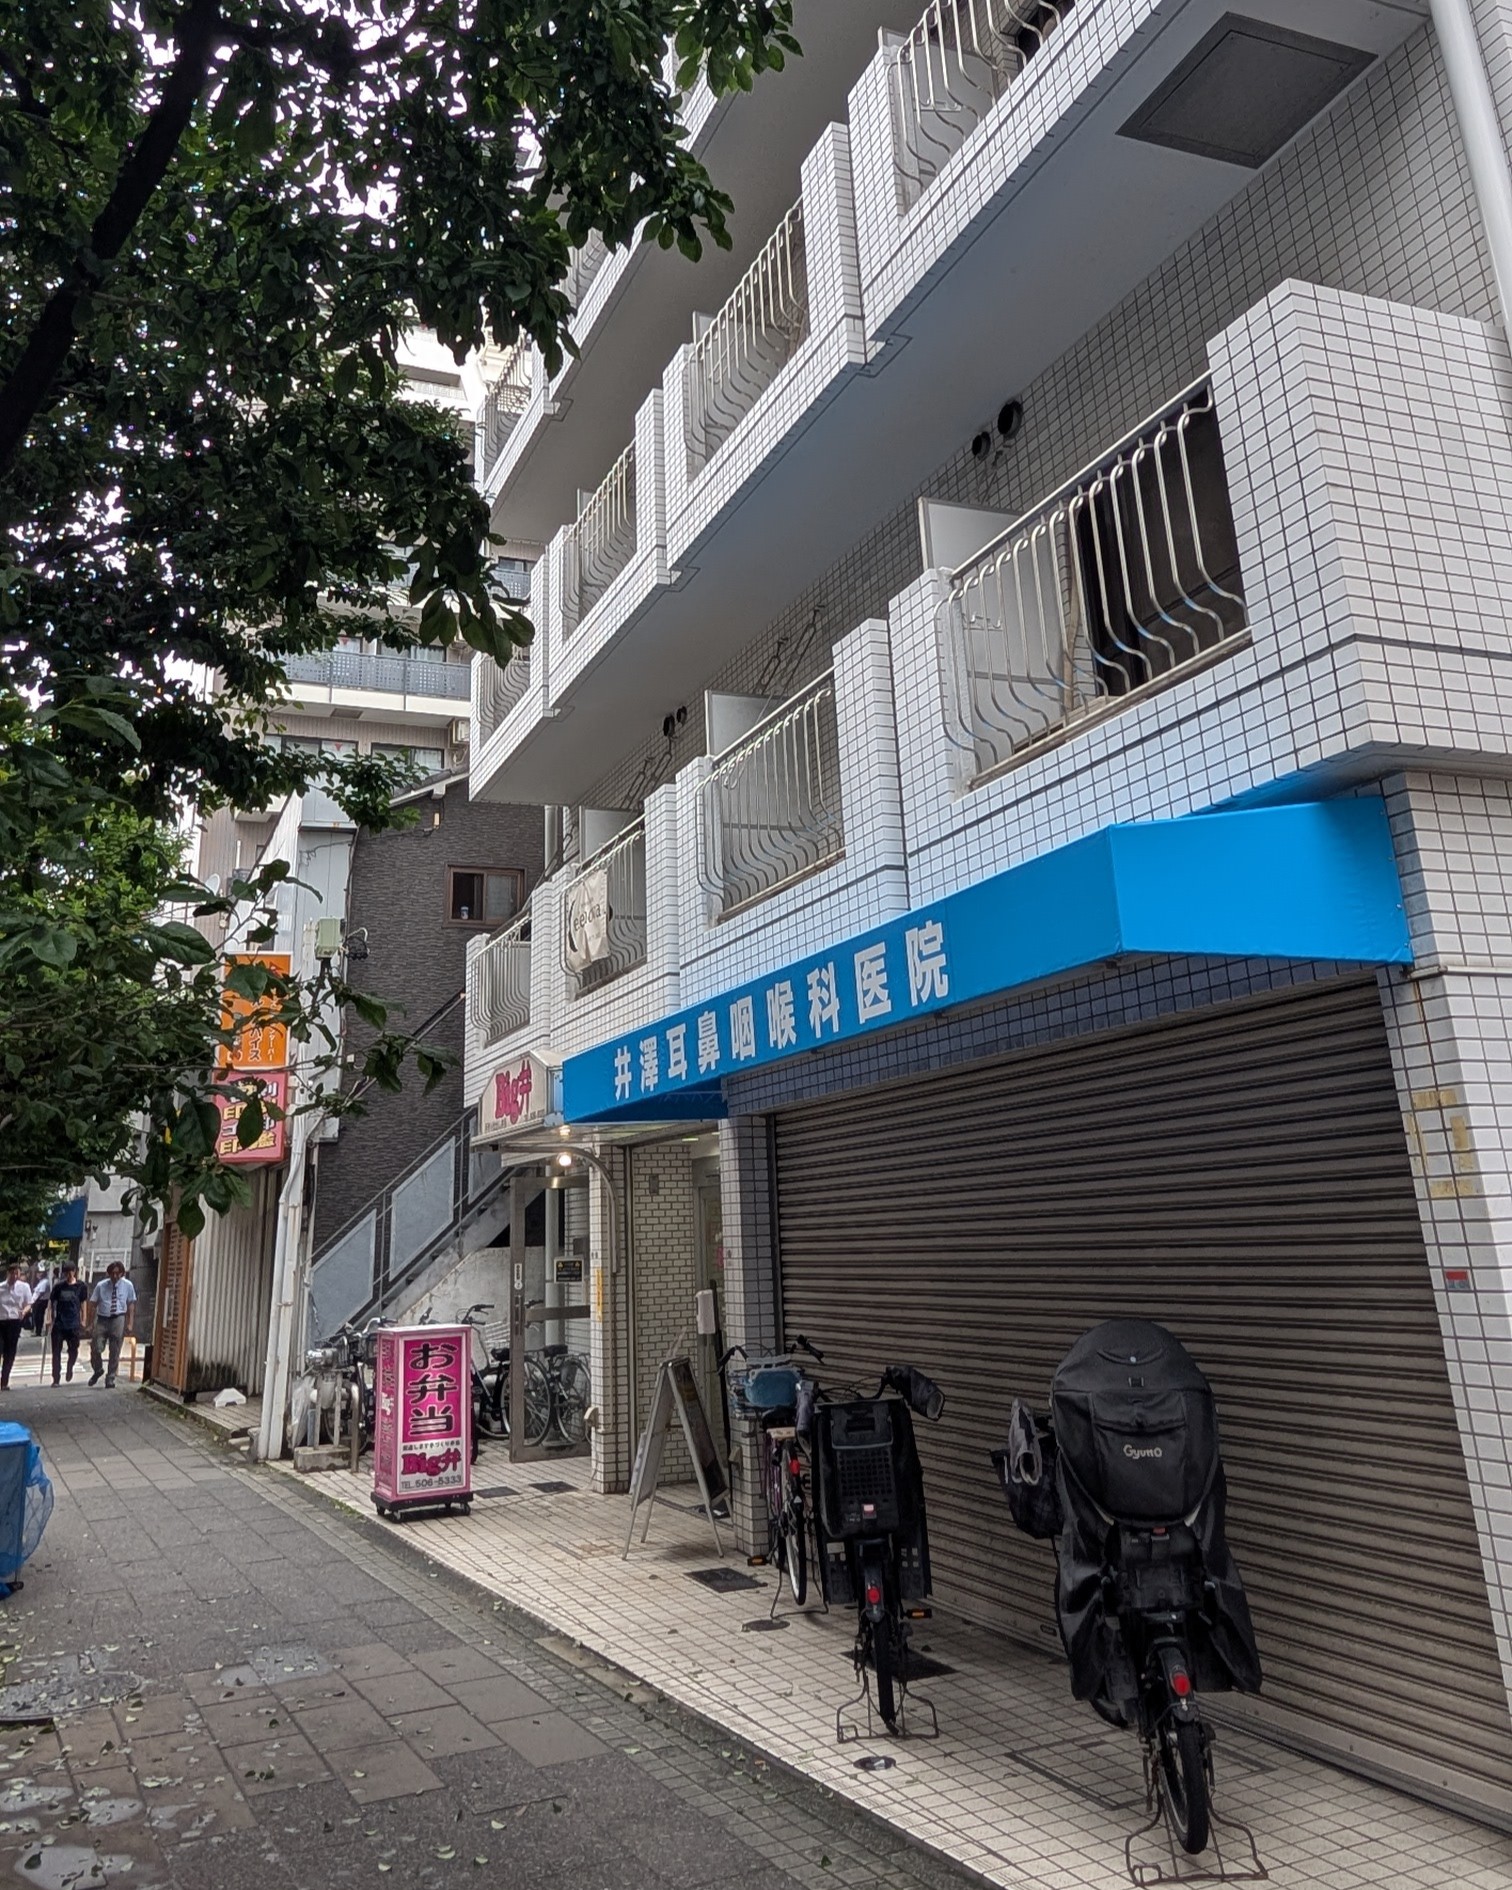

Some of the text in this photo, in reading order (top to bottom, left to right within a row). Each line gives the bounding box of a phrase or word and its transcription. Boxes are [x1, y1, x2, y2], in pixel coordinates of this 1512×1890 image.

[614, 919, 949, 1101] 井澤耳鼻咽喉科医院
[407, 1343, 458, 1436] お弁当
[401, 1447, 462, 1477] Big弁
